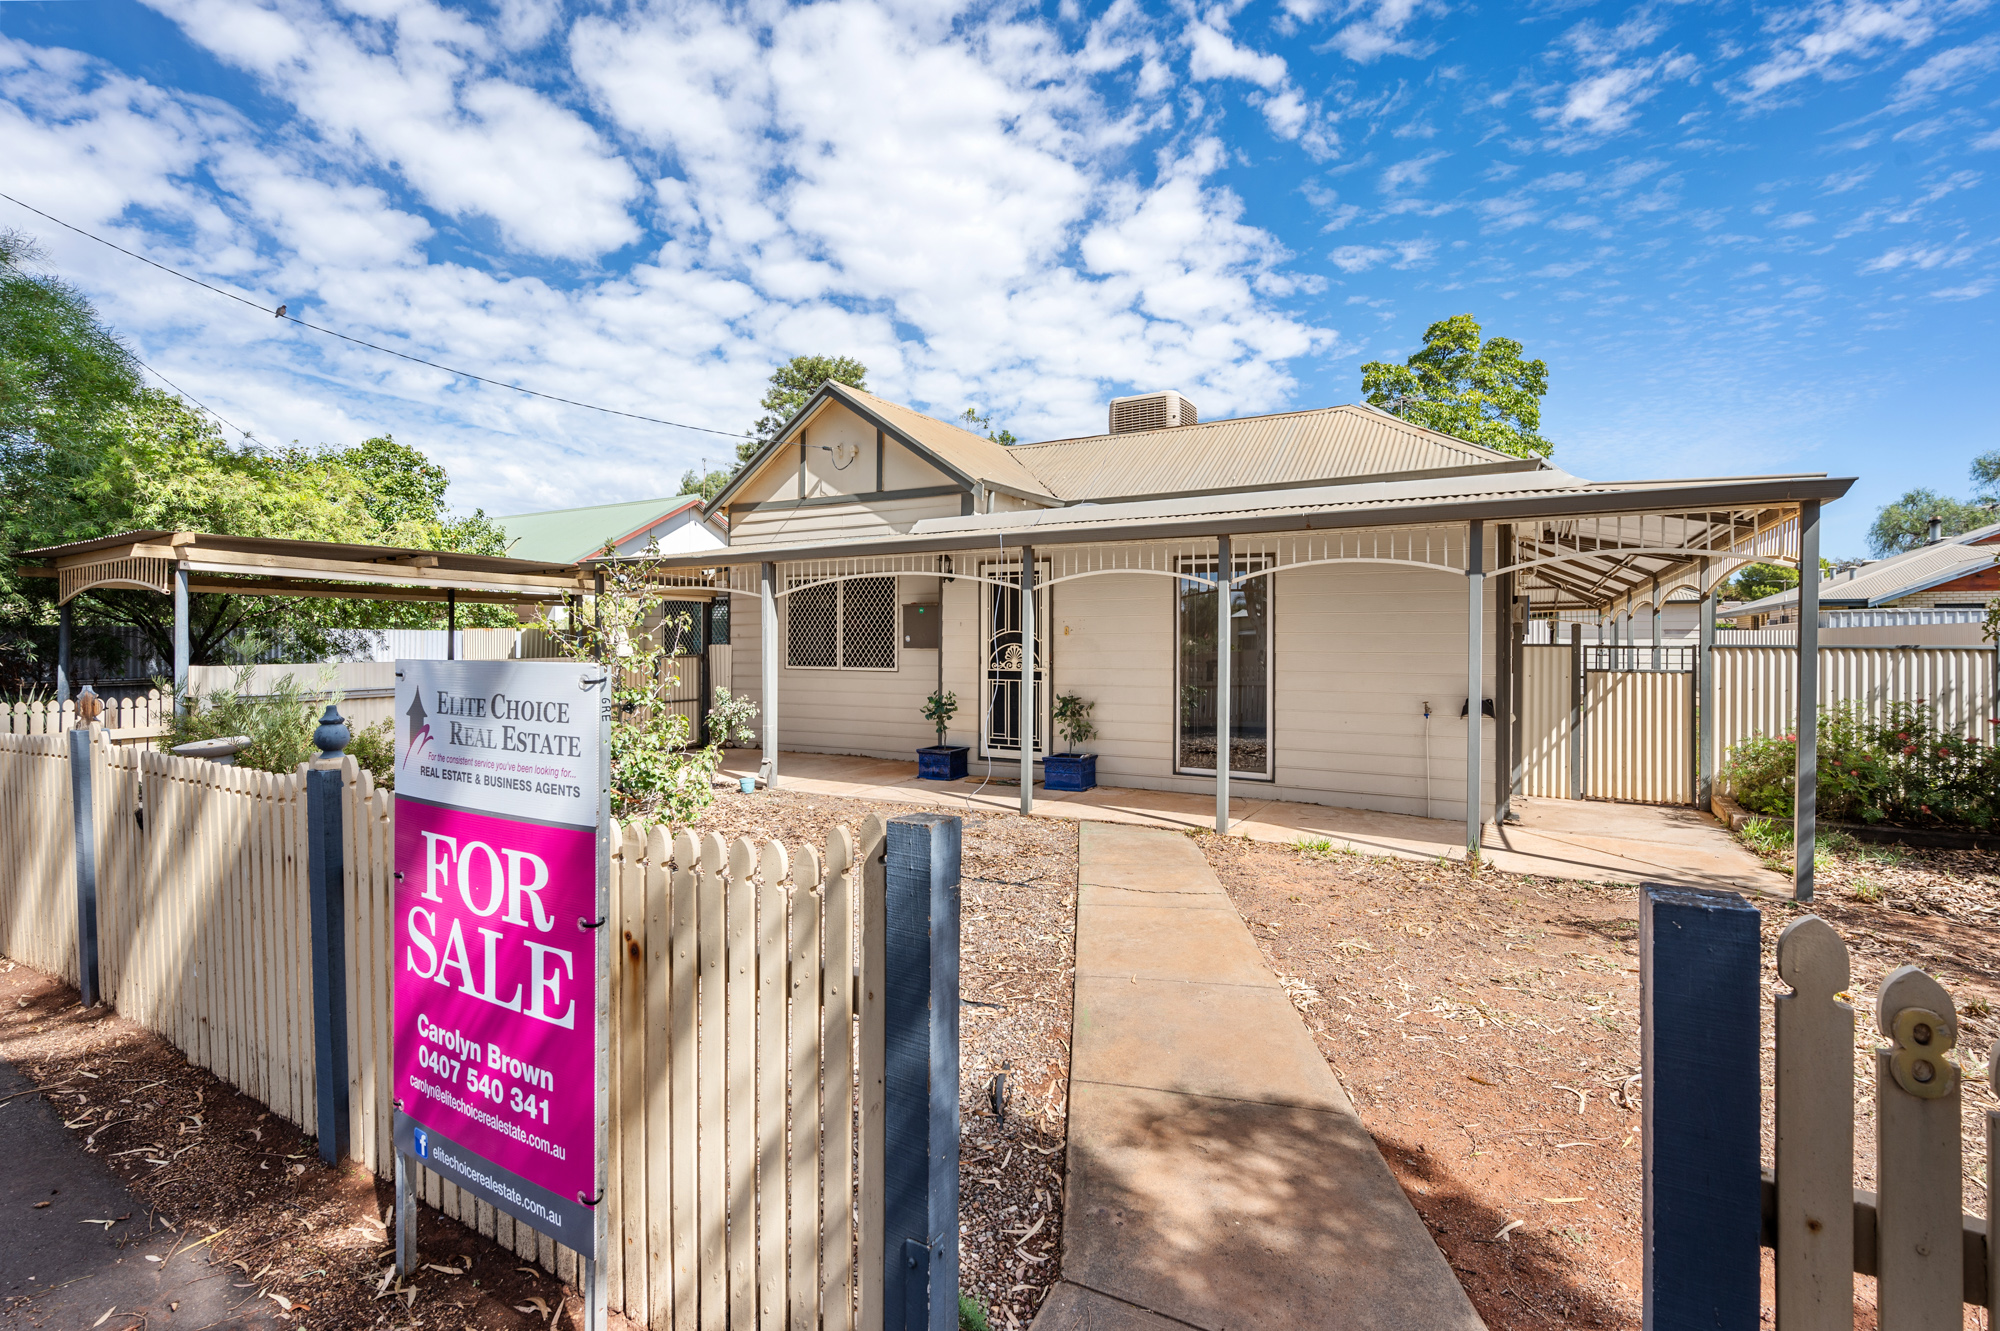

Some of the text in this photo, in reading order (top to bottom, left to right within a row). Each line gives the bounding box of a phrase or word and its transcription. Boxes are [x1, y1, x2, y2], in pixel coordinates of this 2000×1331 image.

[436, 691, 570, 724] ELITE CHOICE
[449, 721, 582, 758] REAL ESTATE
[602, 698, 611, 722] GRE
[420, 766, 580, 798] REAL ESTATE & BUSINESS AGENTS
[428, 752, 436, 761] For
[437, 753, 445, 762] the
[446, 755, 474, 766] consistent
[474, 759, 495, 770] service
[496, 762, 516, 773] you've
[517, 762, 533, 774] been
[534, 765, 559, 778] looking
[421, 830, 554, 932] FOR
[407, 906, 575, 1030] SALE
[417, 1014, 554, 1092] Carolyn Brown
[418, 1045, 548, 1124] 0407 540 341
[1890, 1006, 1956, 1099] 8
[410, 1074, 566, 1160] carolyn@elitechoicerealestate.com.au
[433, 1145, 562, 1226] elitechoicerealestate.com.au
